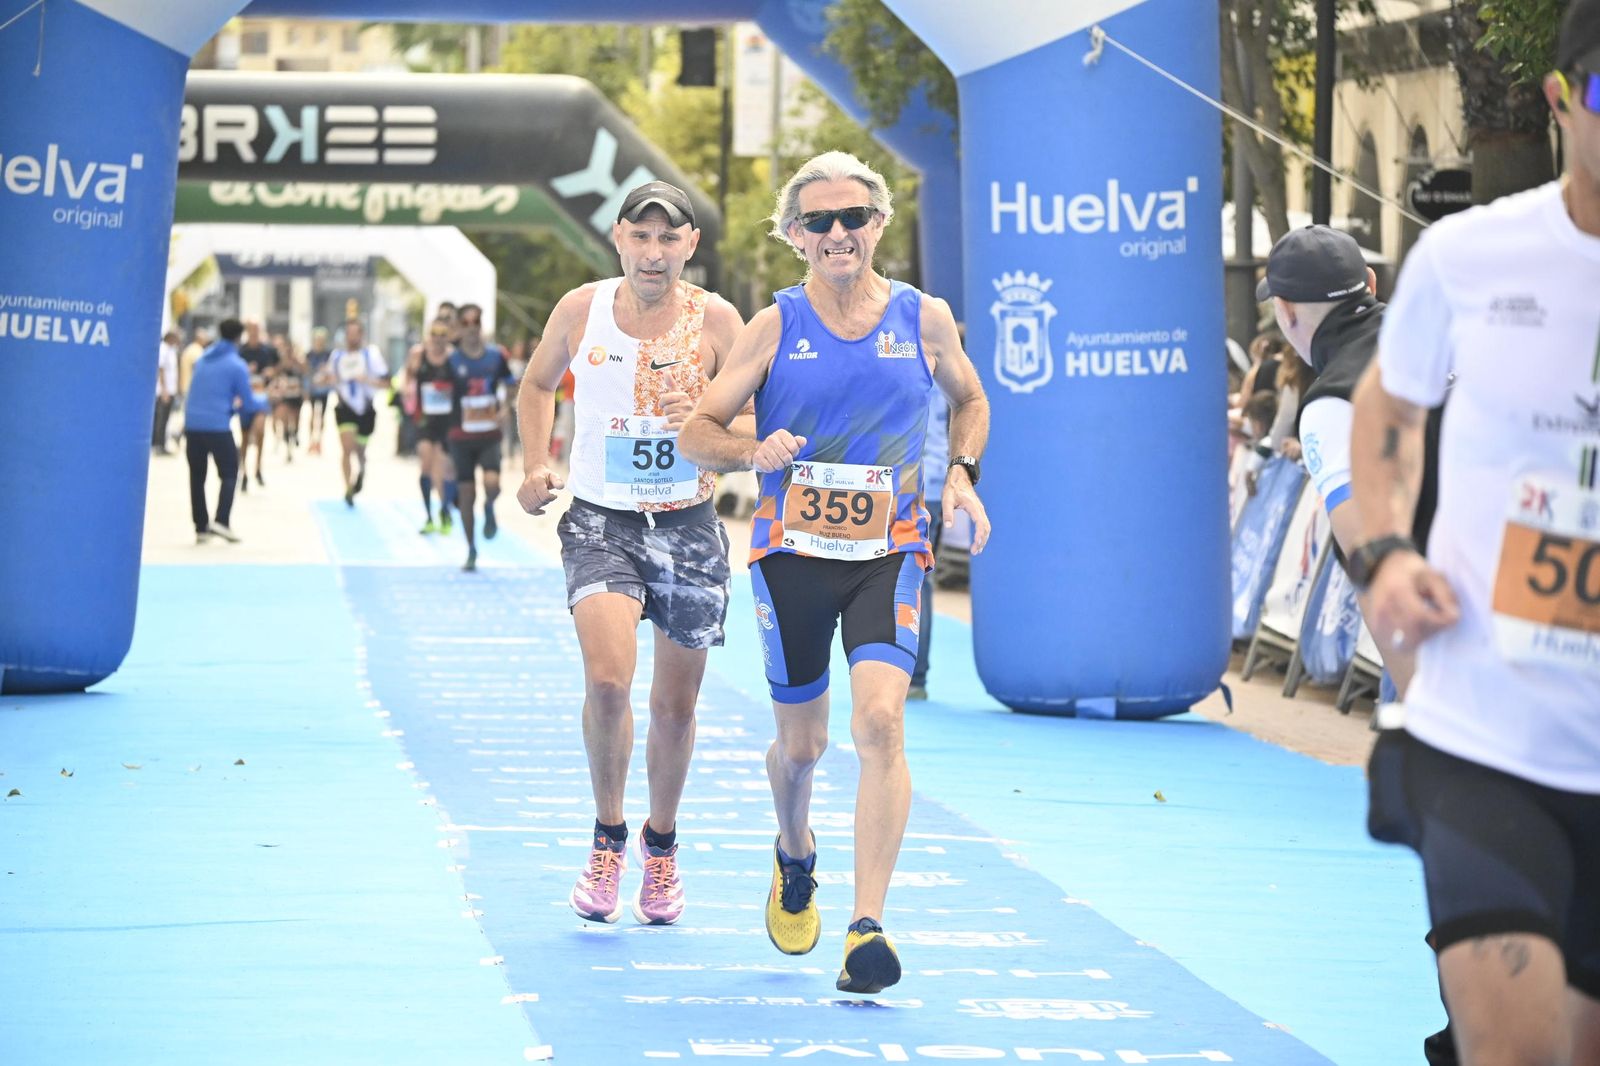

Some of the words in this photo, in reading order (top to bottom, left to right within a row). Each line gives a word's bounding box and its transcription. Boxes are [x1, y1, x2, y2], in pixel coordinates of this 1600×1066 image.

[0, 144, 127, 204] elva
[991, 178, 1186, 234] Huelva
[53, 205, 124, 230] original
[1120, 235, 1187, 261] original
[0, 294, 94, 314] yuntamiento
[97, 300, 114, 316] de
[1066, 331, 1169, 349] Ayuntamiento
[1172, 328, 1188, 343] de
[609, 354, 623, 363] NN
[789, 351, 818, 360] VIATOR
[1065, 347, 1188, 377] HUELVA
[610, 417, 630, 432] 2K
[632, 439, 675, 470] 58
[799, 464, 814, 480] 2K
[866, 469, 885, 485] 2K
[630, 484, 672, 496] Huelva
[800, 487, 874, 526] 359
[810, 536, 854, 553] Huelva
[832, 531, 851, 539] BUENO
